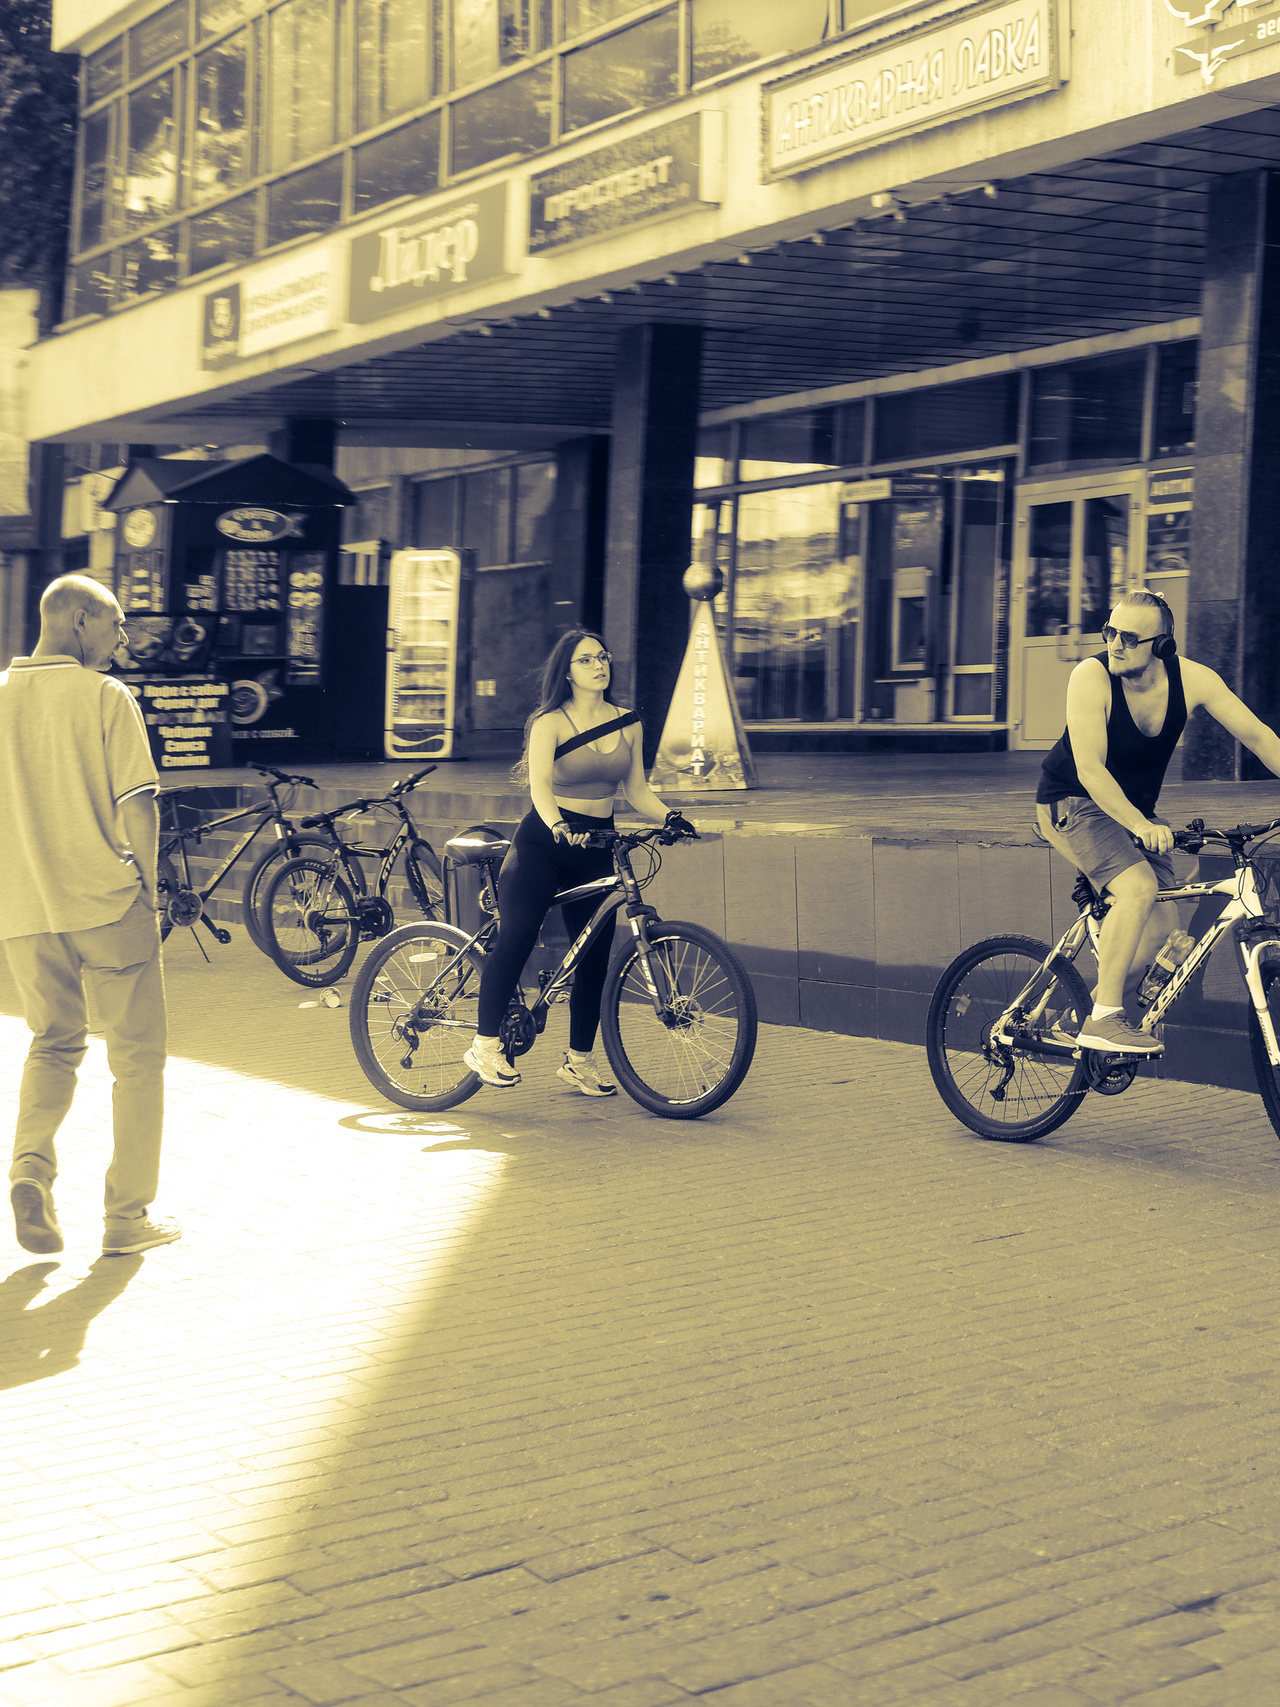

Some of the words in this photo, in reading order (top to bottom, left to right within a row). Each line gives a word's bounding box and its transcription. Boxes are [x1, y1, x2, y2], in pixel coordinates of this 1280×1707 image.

[776, 48, 945, 154] АНТИКВАРНАЯ
[952, 8, 1041, 97] ЛАВКА
[143, 684, 179, 698] Кофе
[189, 682, 229, 696] собой
[690, 621, 710, 776] АНТИКВАРИАТ
[381, 837, 403, 883] STELS
[1142, 920, 1217, 1027] KROSS
